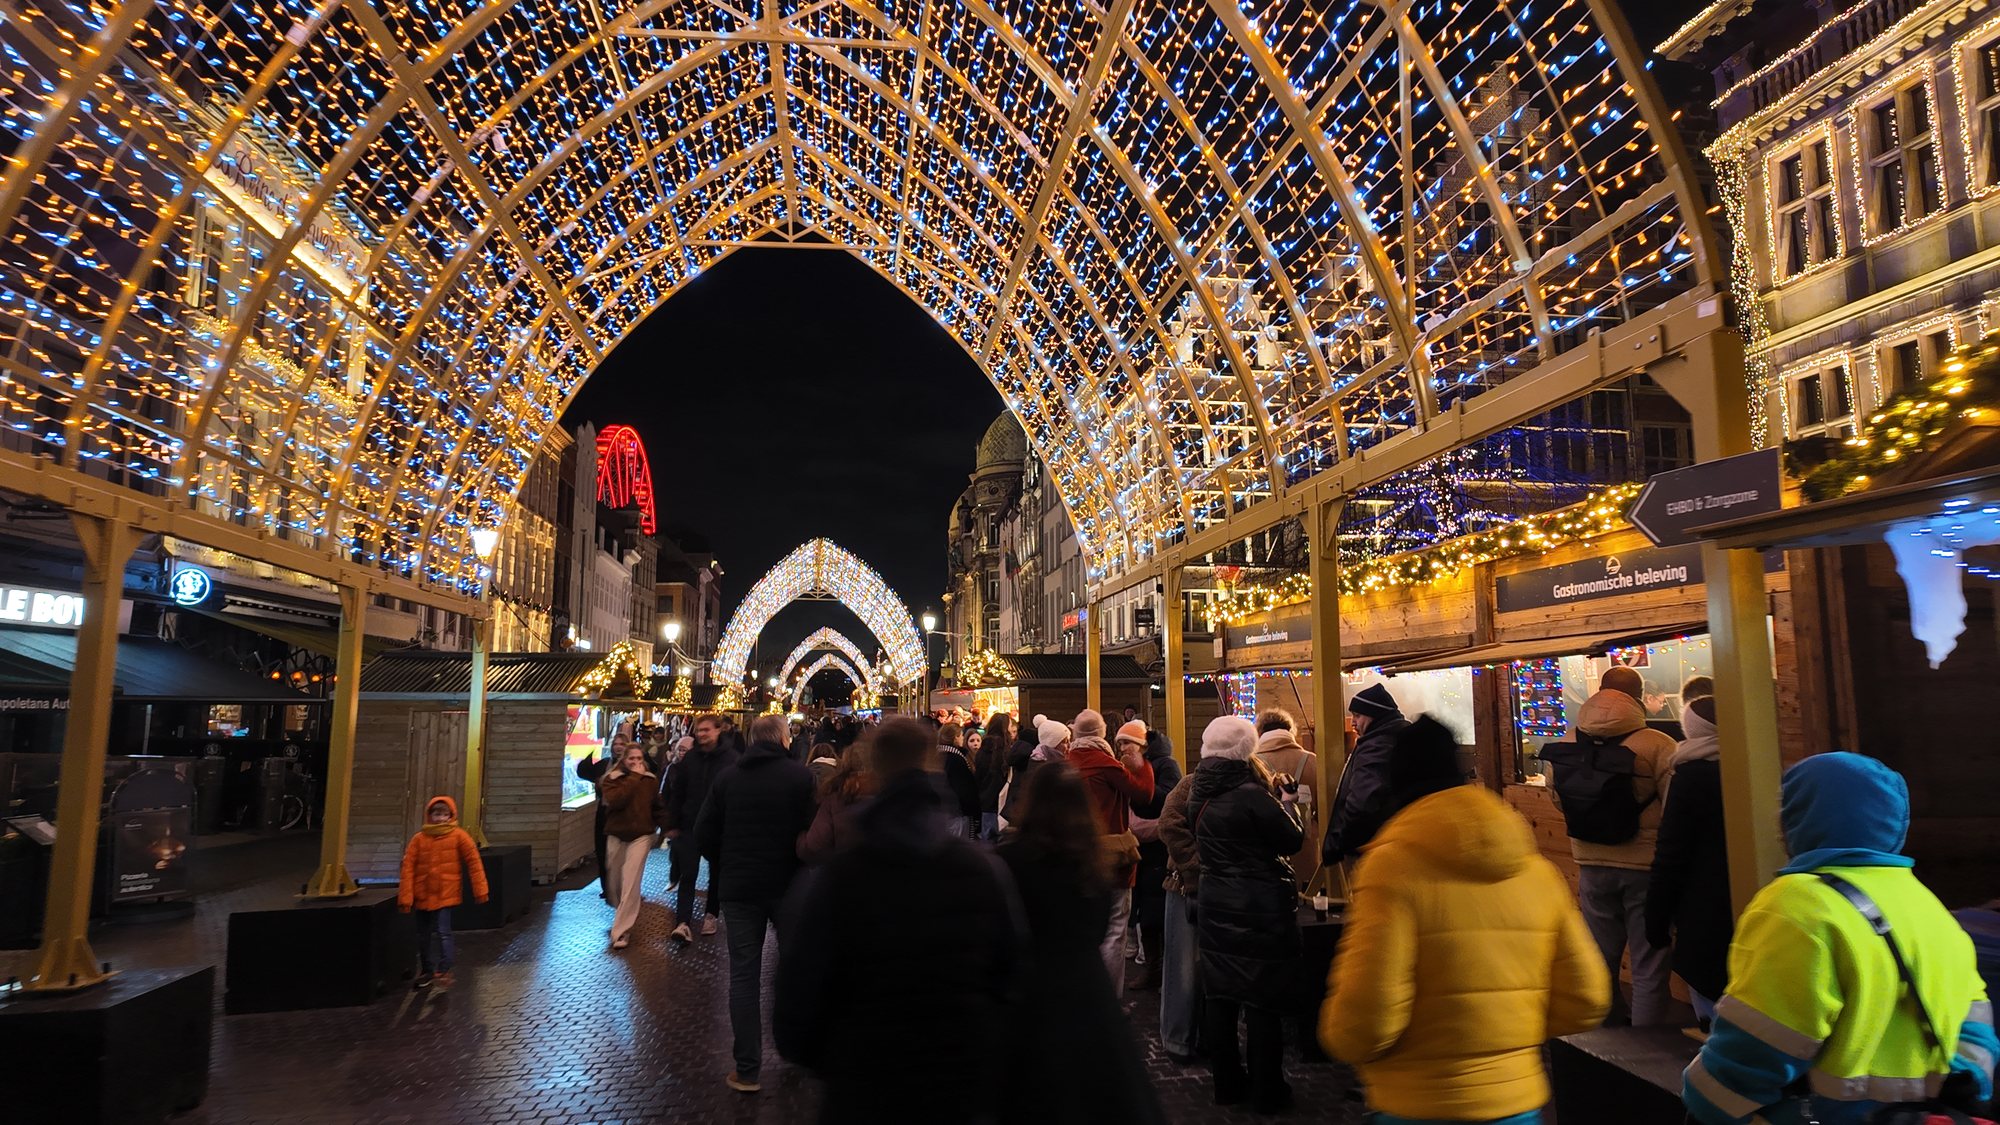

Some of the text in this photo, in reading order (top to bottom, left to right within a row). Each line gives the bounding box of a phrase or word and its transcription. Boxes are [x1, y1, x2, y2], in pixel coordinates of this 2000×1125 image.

[229, 149, 275, 212] Reine
[1666, 490, 1760, 516] EHBO & Zorgzone
[1553, 563, 1688, 599] Gastronomische beleving
